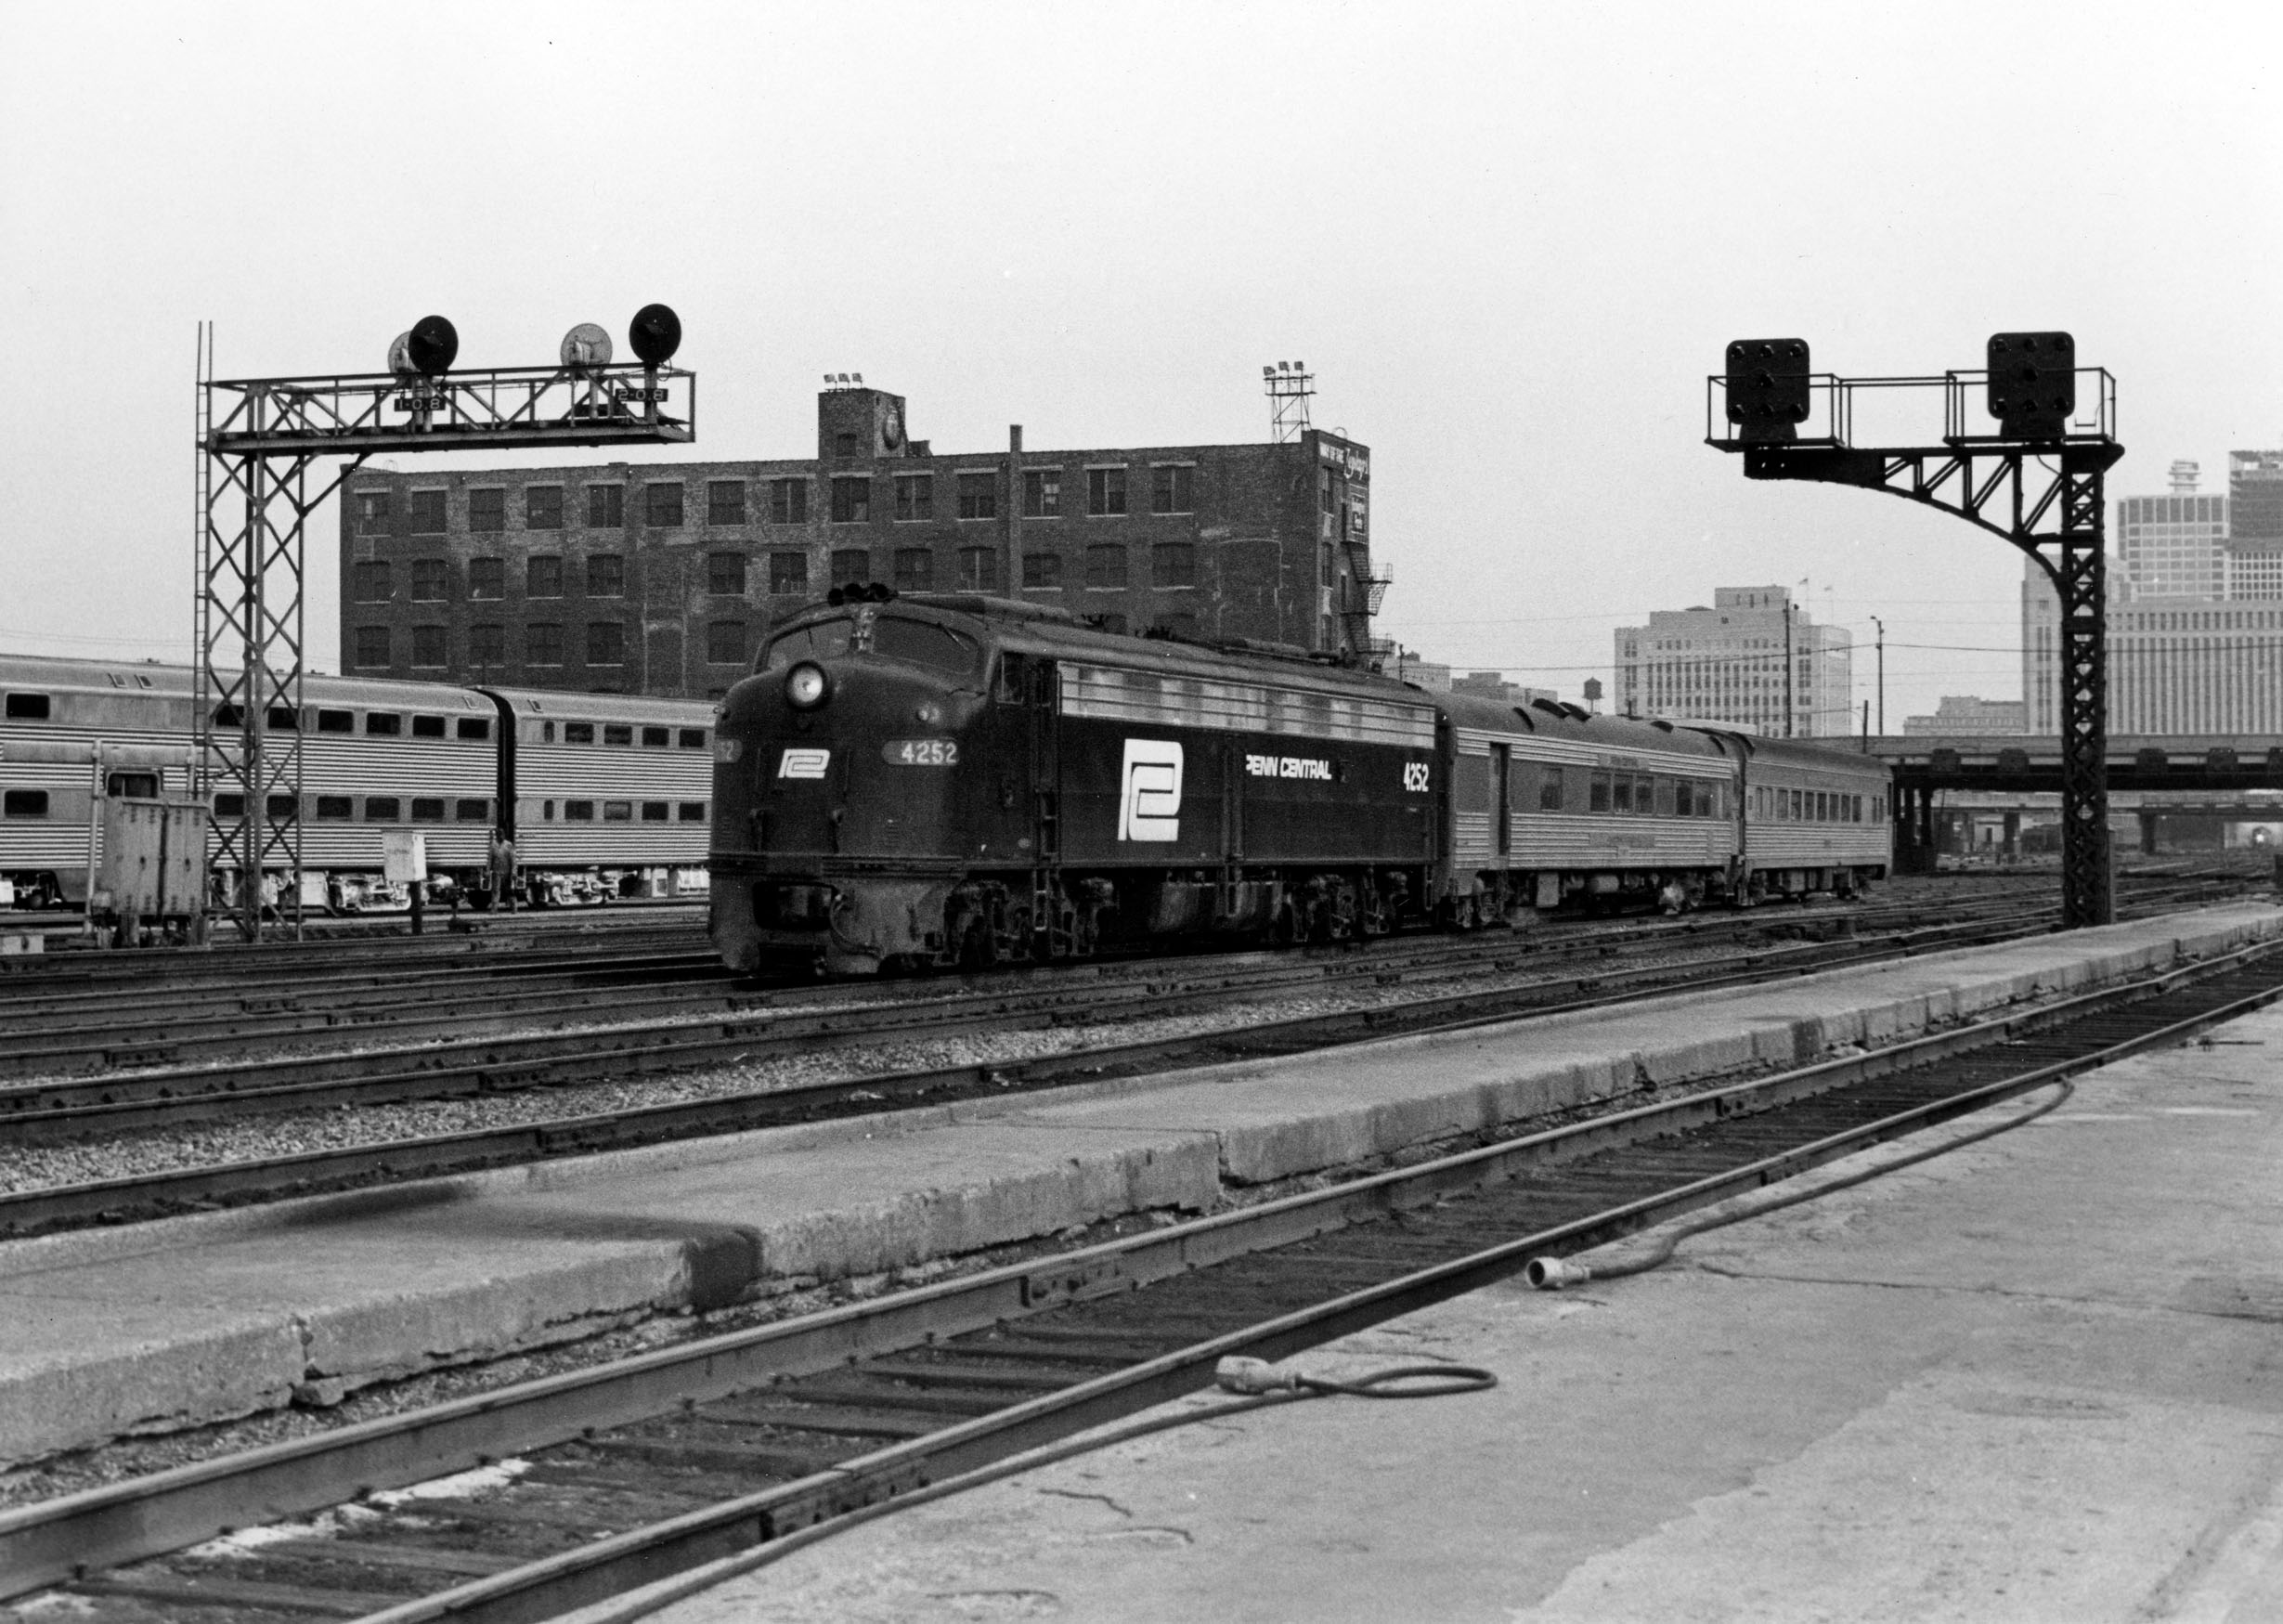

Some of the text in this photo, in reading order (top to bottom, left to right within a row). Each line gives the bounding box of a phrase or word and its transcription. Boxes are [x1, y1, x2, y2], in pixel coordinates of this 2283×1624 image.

[399, 398, 440, 409] 1-0.8
[617, 389, 663, 400] 2-0.8
[902, 742, 957, 764] 4252
[1246, 754, 1332, 780] PENN CENTRAL
[1403, 762, 1429, 792] 4252
